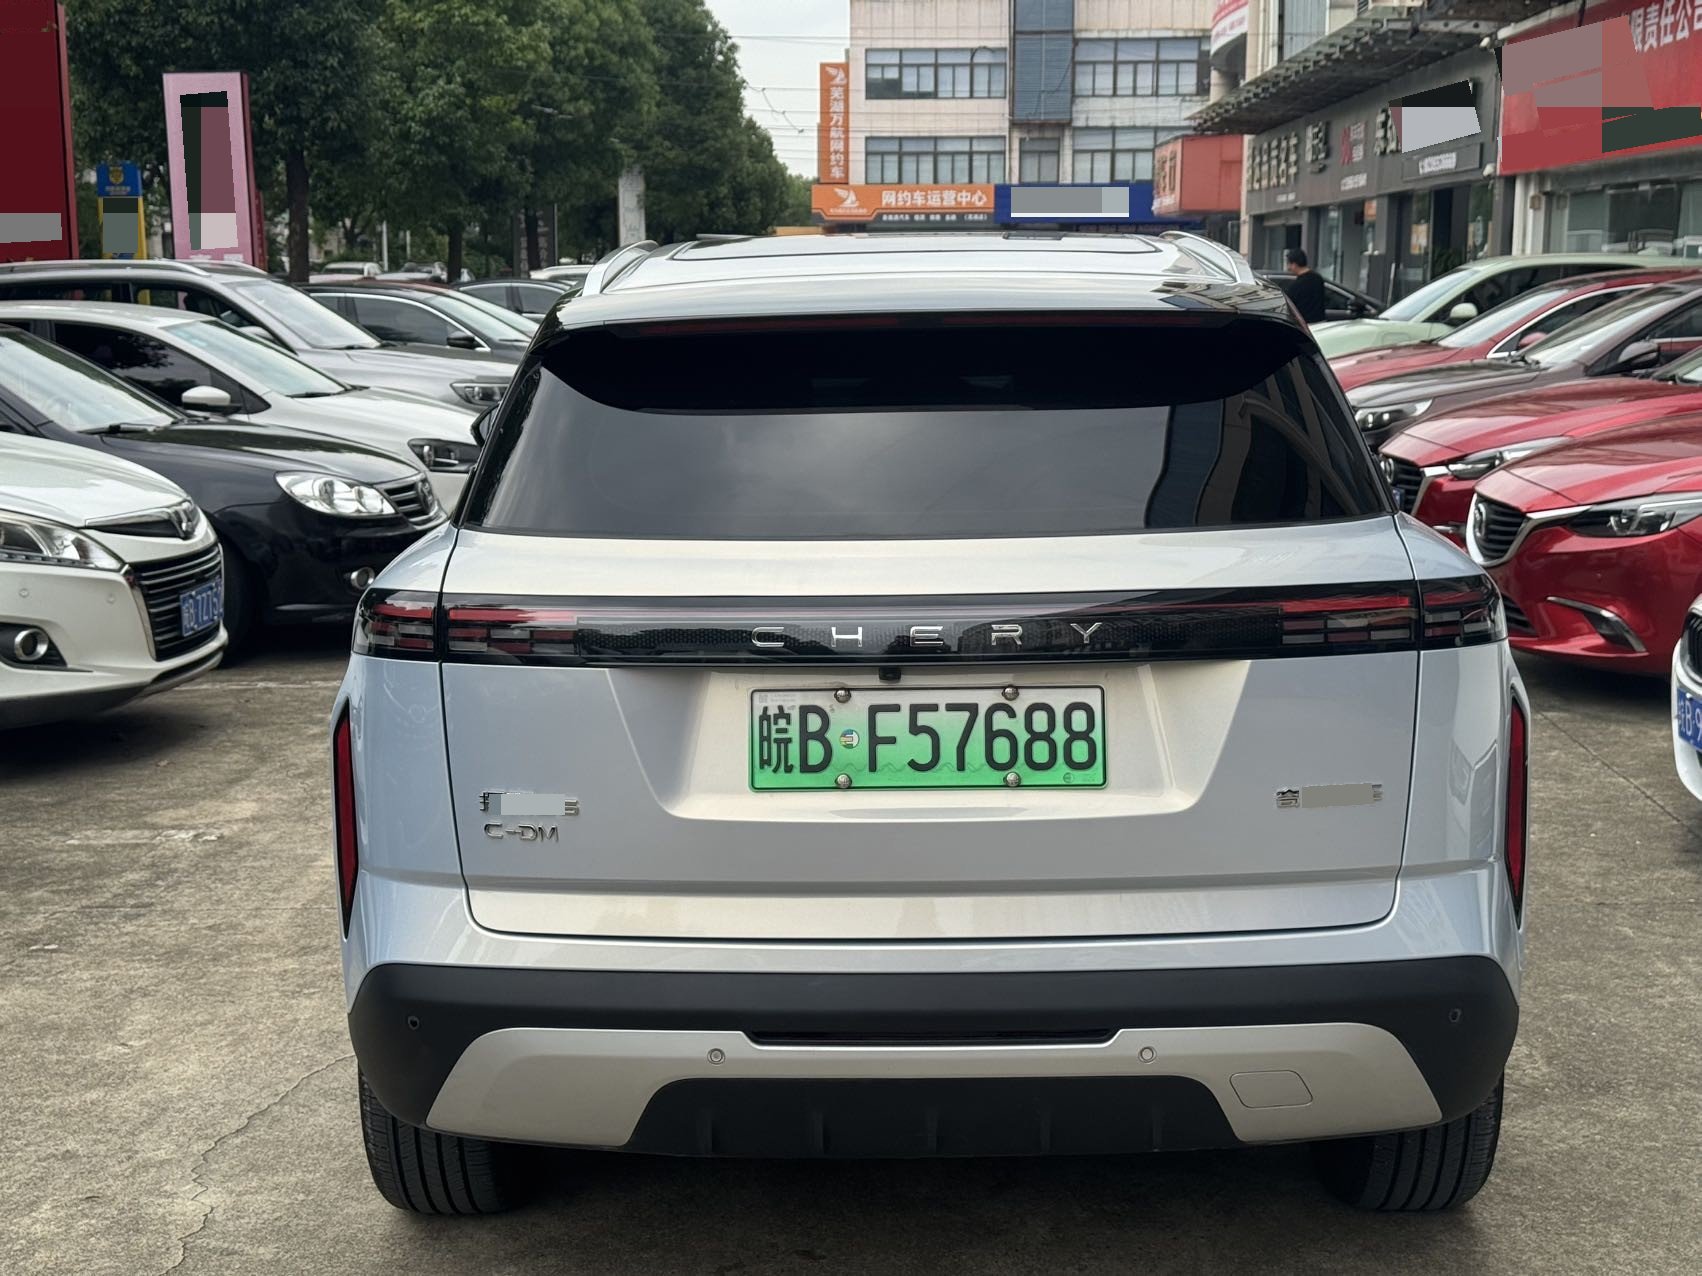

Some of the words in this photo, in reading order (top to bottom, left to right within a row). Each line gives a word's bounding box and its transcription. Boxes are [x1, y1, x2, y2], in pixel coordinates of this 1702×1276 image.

[881, 189, 988, 207] 网约车运营中心
[751, 622, 1103, 649] CHERY
[484, 823, 560, 842] C-DM
